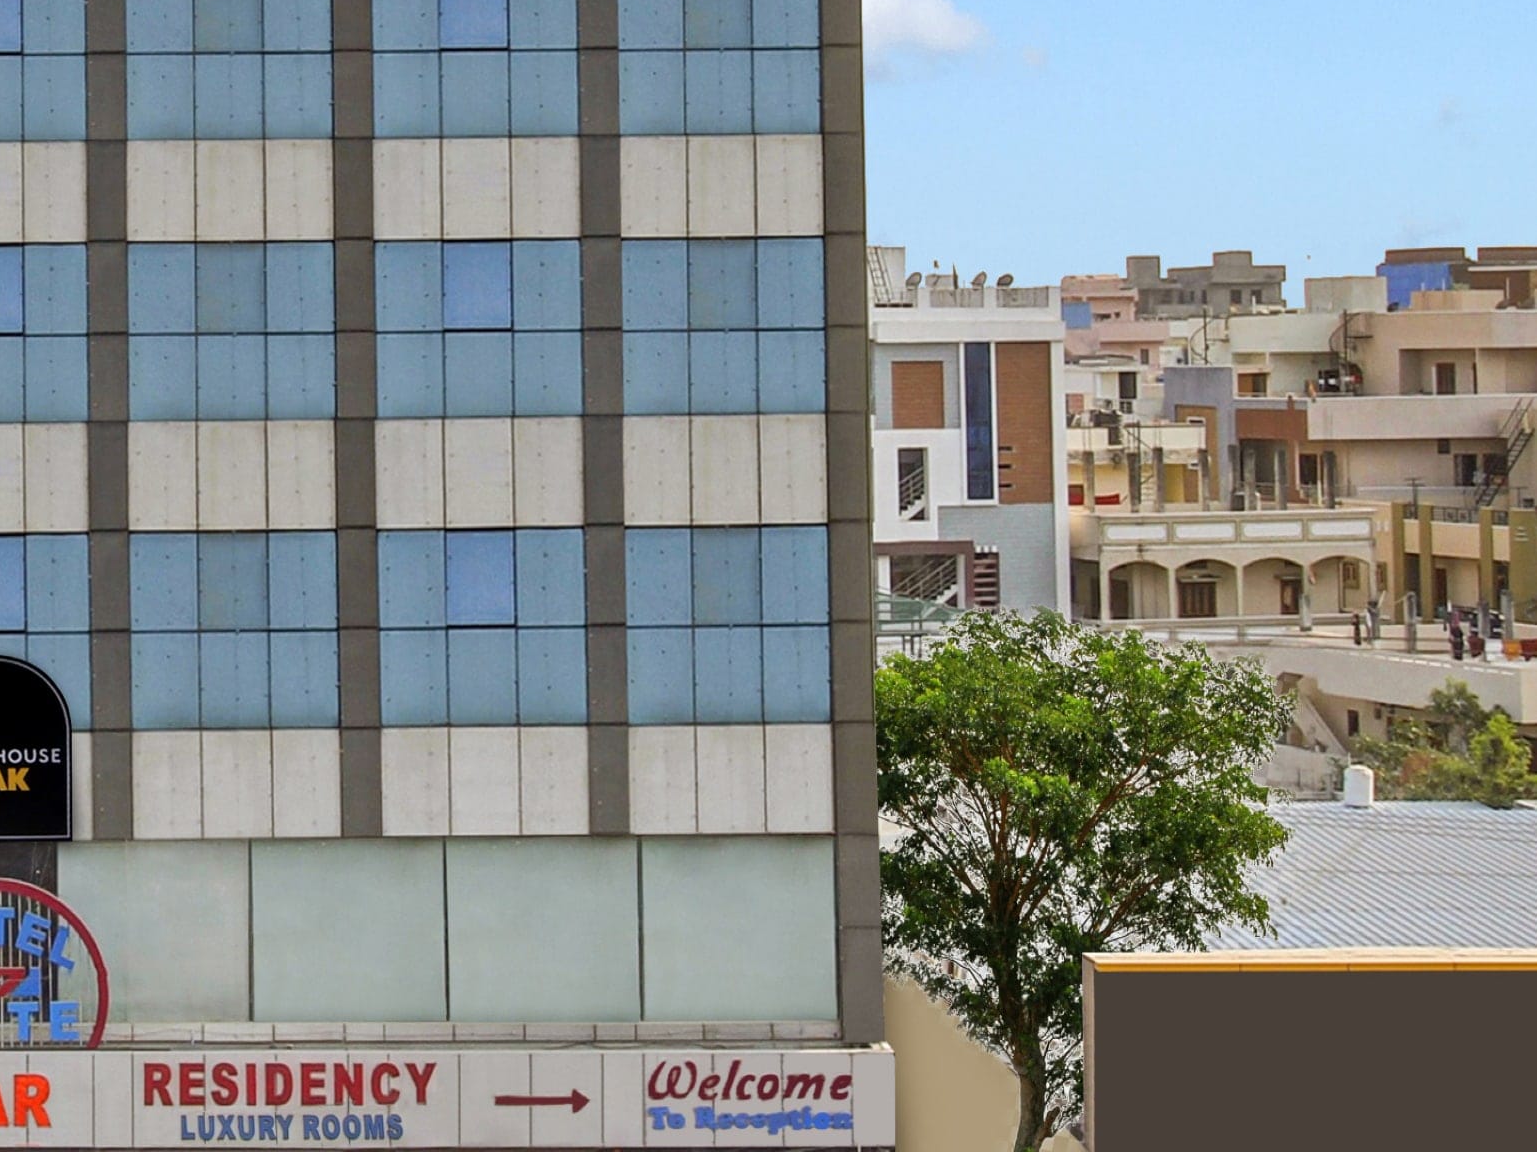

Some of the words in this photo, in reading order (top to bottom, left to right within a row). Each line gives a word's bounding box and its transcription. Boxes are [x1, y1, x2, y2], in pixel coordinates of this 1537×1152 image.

[143, 1061, 438, 1107] RESIDENCY
[647, 1059, 853, 1101] Welcome
[180, 1113, 295, 1141] LUXURY
[302, 1113, 405, 1141] ROOMS
[647, 1105, 687, 1131] To
[693, 1105, 854, 1136] Reception
